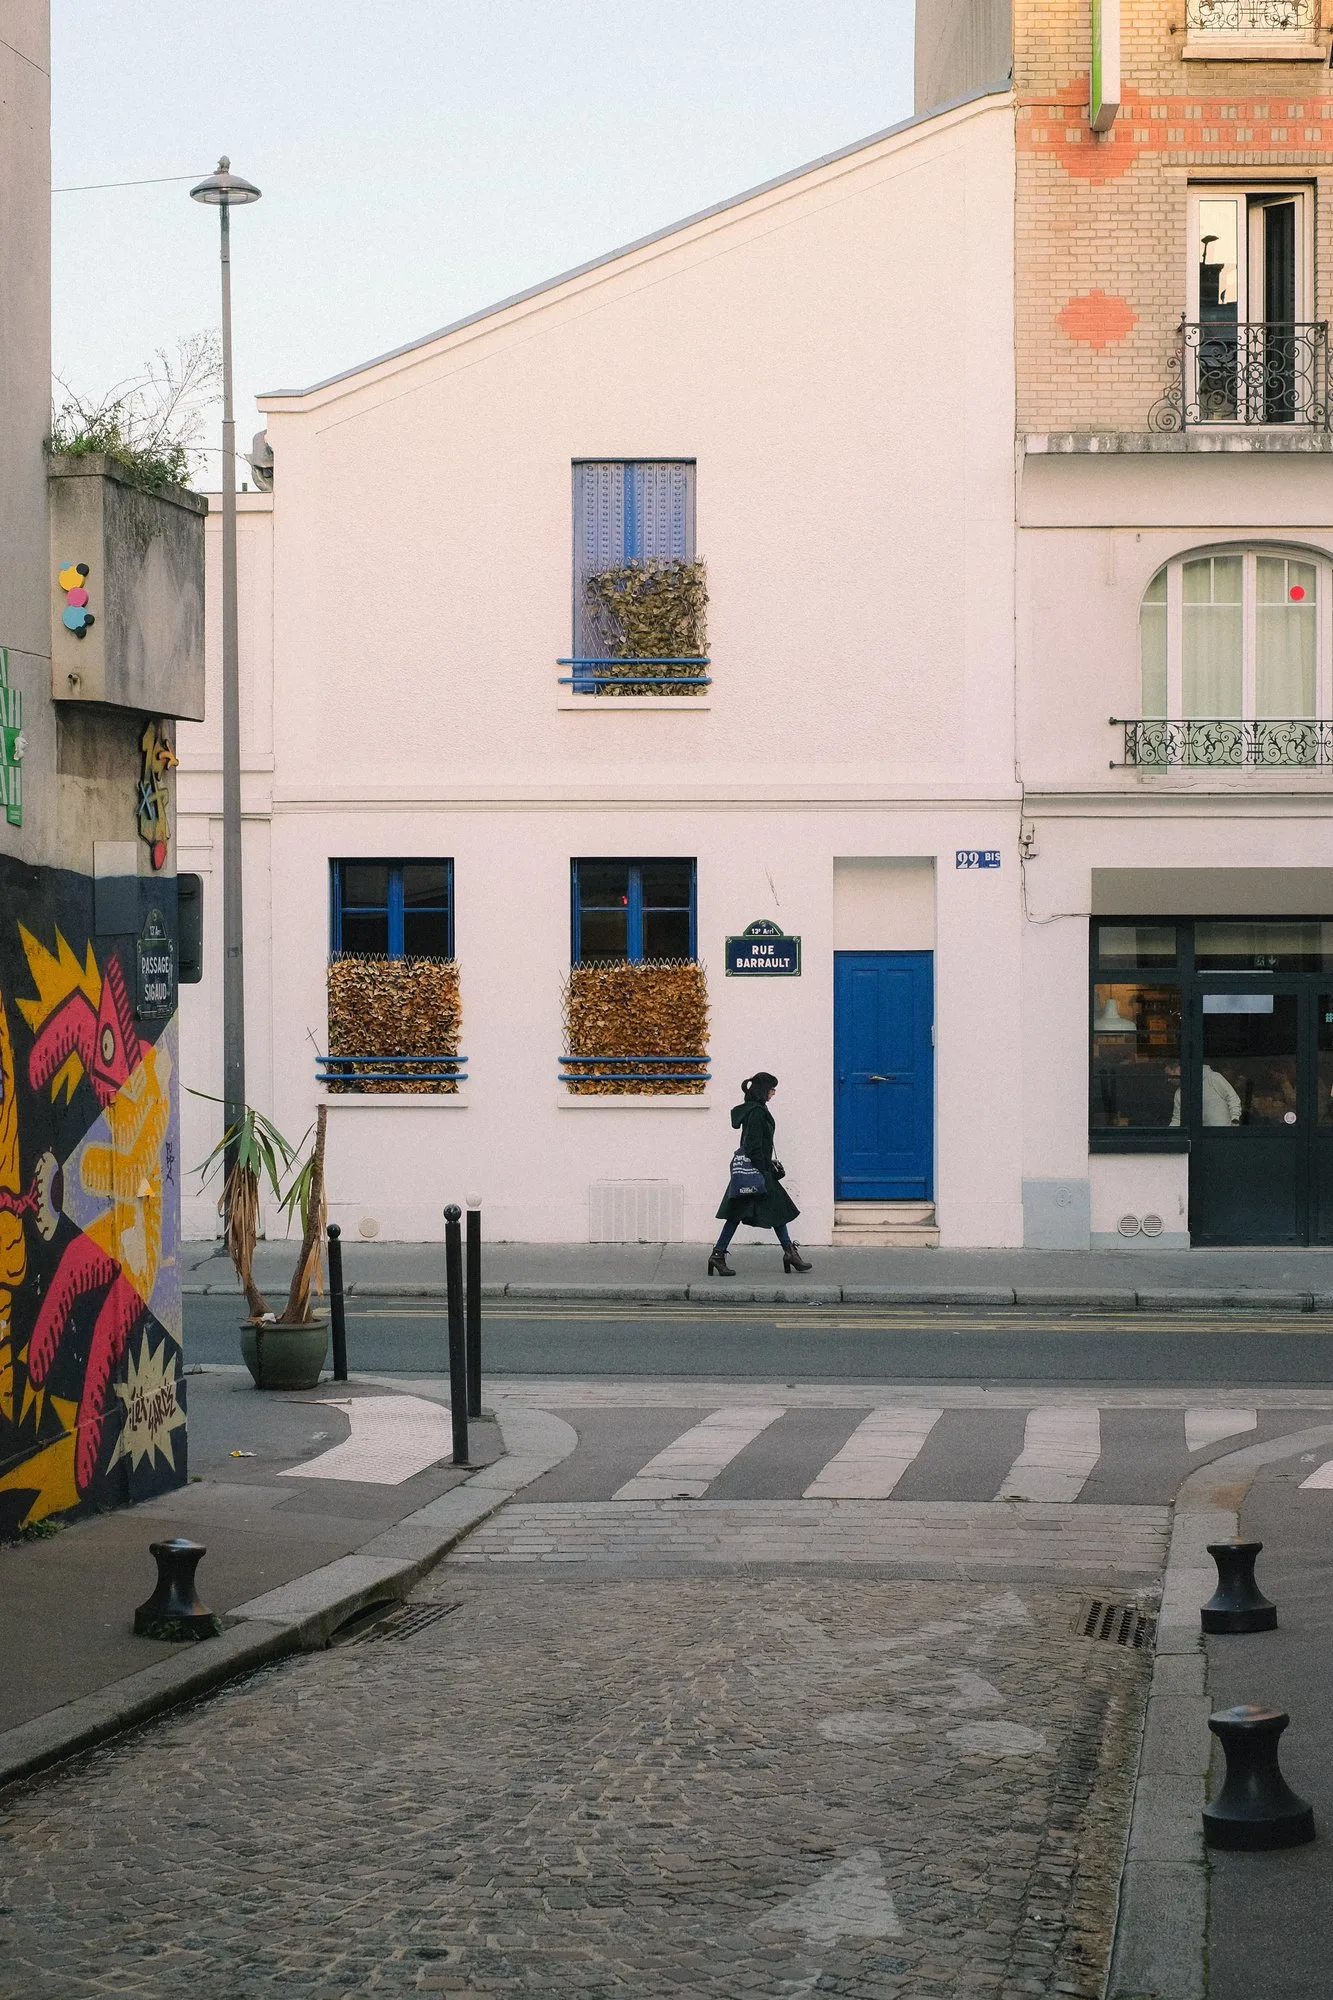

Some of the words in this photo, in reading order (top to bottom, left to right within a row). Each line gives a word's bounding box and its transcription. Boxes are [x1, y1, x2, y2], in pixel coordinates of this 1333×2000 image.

[957, 851, 979, 869] 22
[984, 852, 1001, 861] BIS
[751, 945, 775, 955] RUE
[141, 956, 169, 974] PASSAGE
[736, 958, 790, 968] BARRAULT
[144, 983, 167, 1001] SIGAUD
